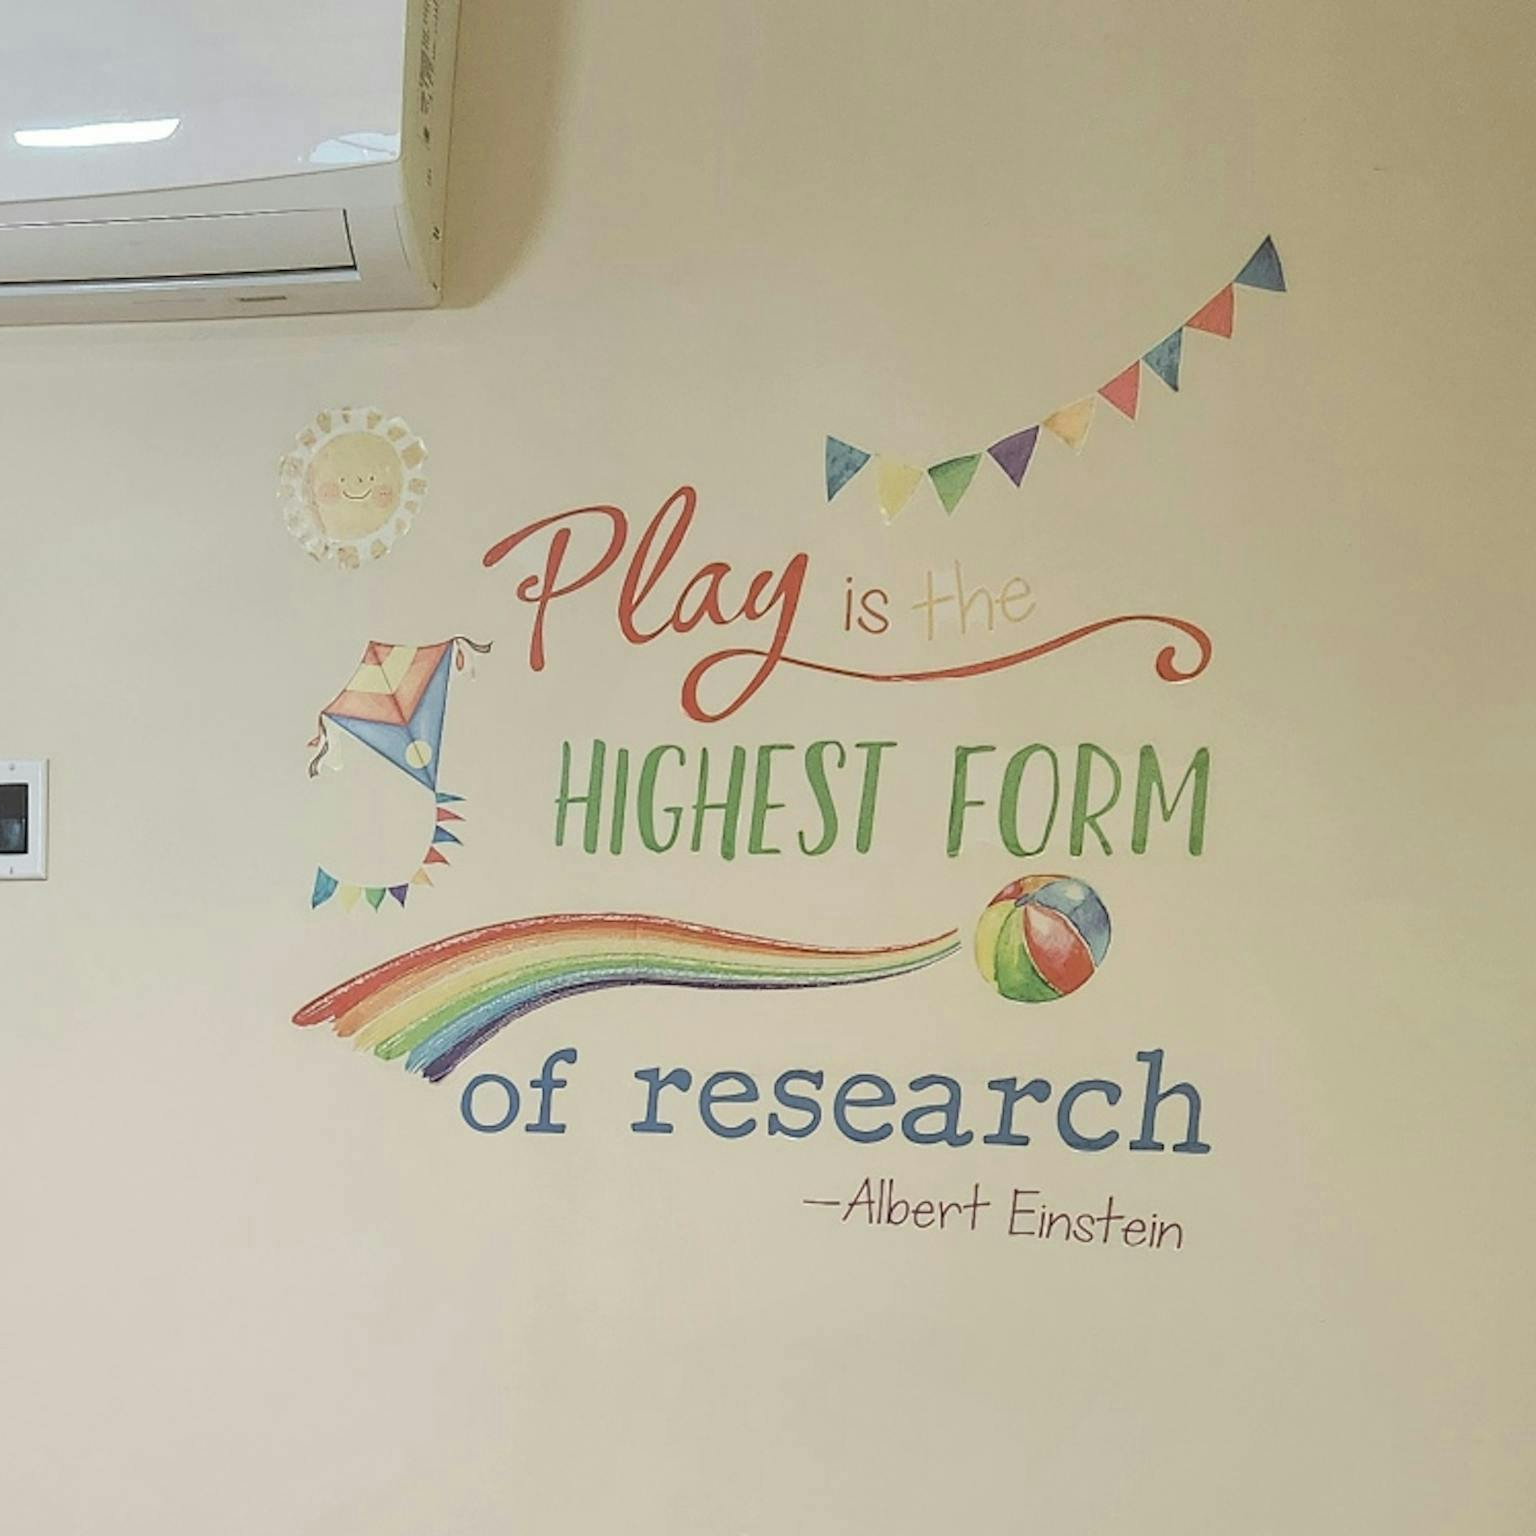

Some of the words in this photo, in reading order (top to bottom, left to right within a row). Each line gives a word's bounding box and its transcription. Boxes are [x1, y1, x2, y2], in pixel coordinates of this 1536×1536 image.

[845, 577, 889, 634] is
[911, 559, 1037, 641] the
[554, 738, 898, 862] HIGHEST
[947, 742, 1212, 859] FORM
[461, 1048, 577, 1134] of
[631, 1048, 1212, 1154] research
[1008, 1188, 1184, 1250] Einstein
